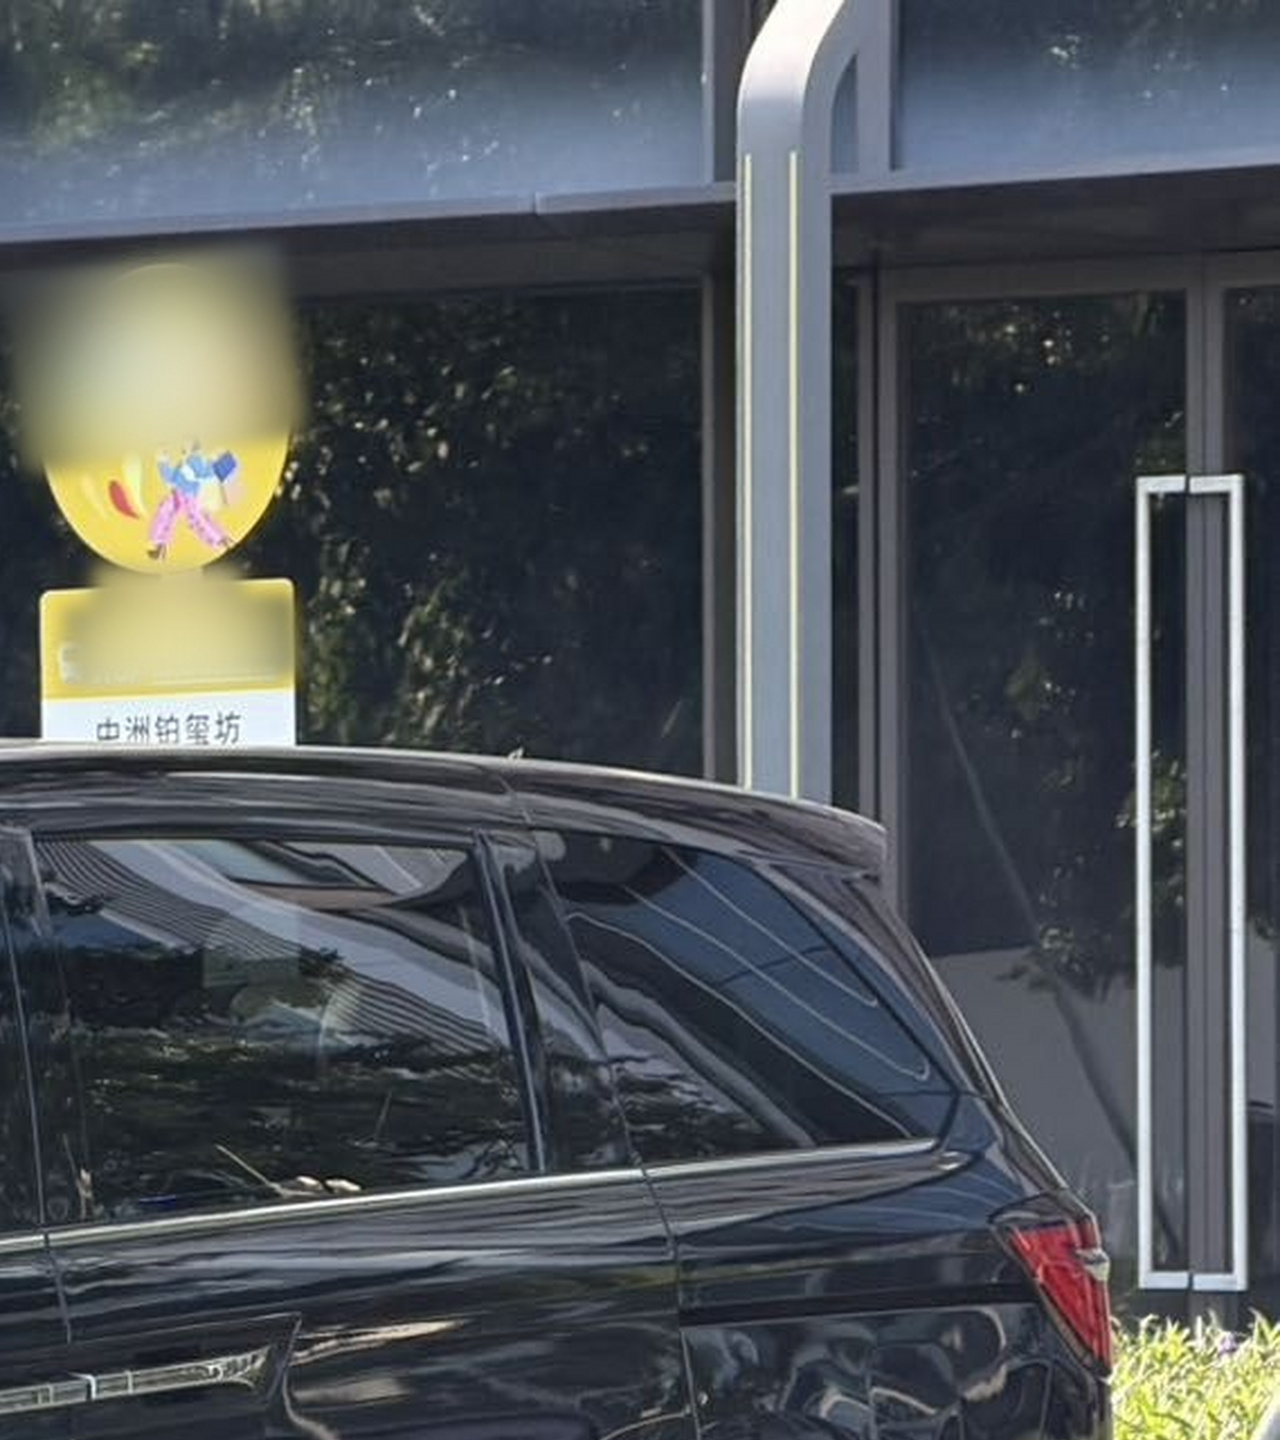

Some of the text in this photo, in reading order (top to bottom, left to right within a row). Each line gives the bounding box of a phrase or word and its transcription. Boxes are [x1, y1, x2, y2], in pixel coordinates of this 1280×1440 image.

[95, 710, 243, 745] 中洲铂玺坊
